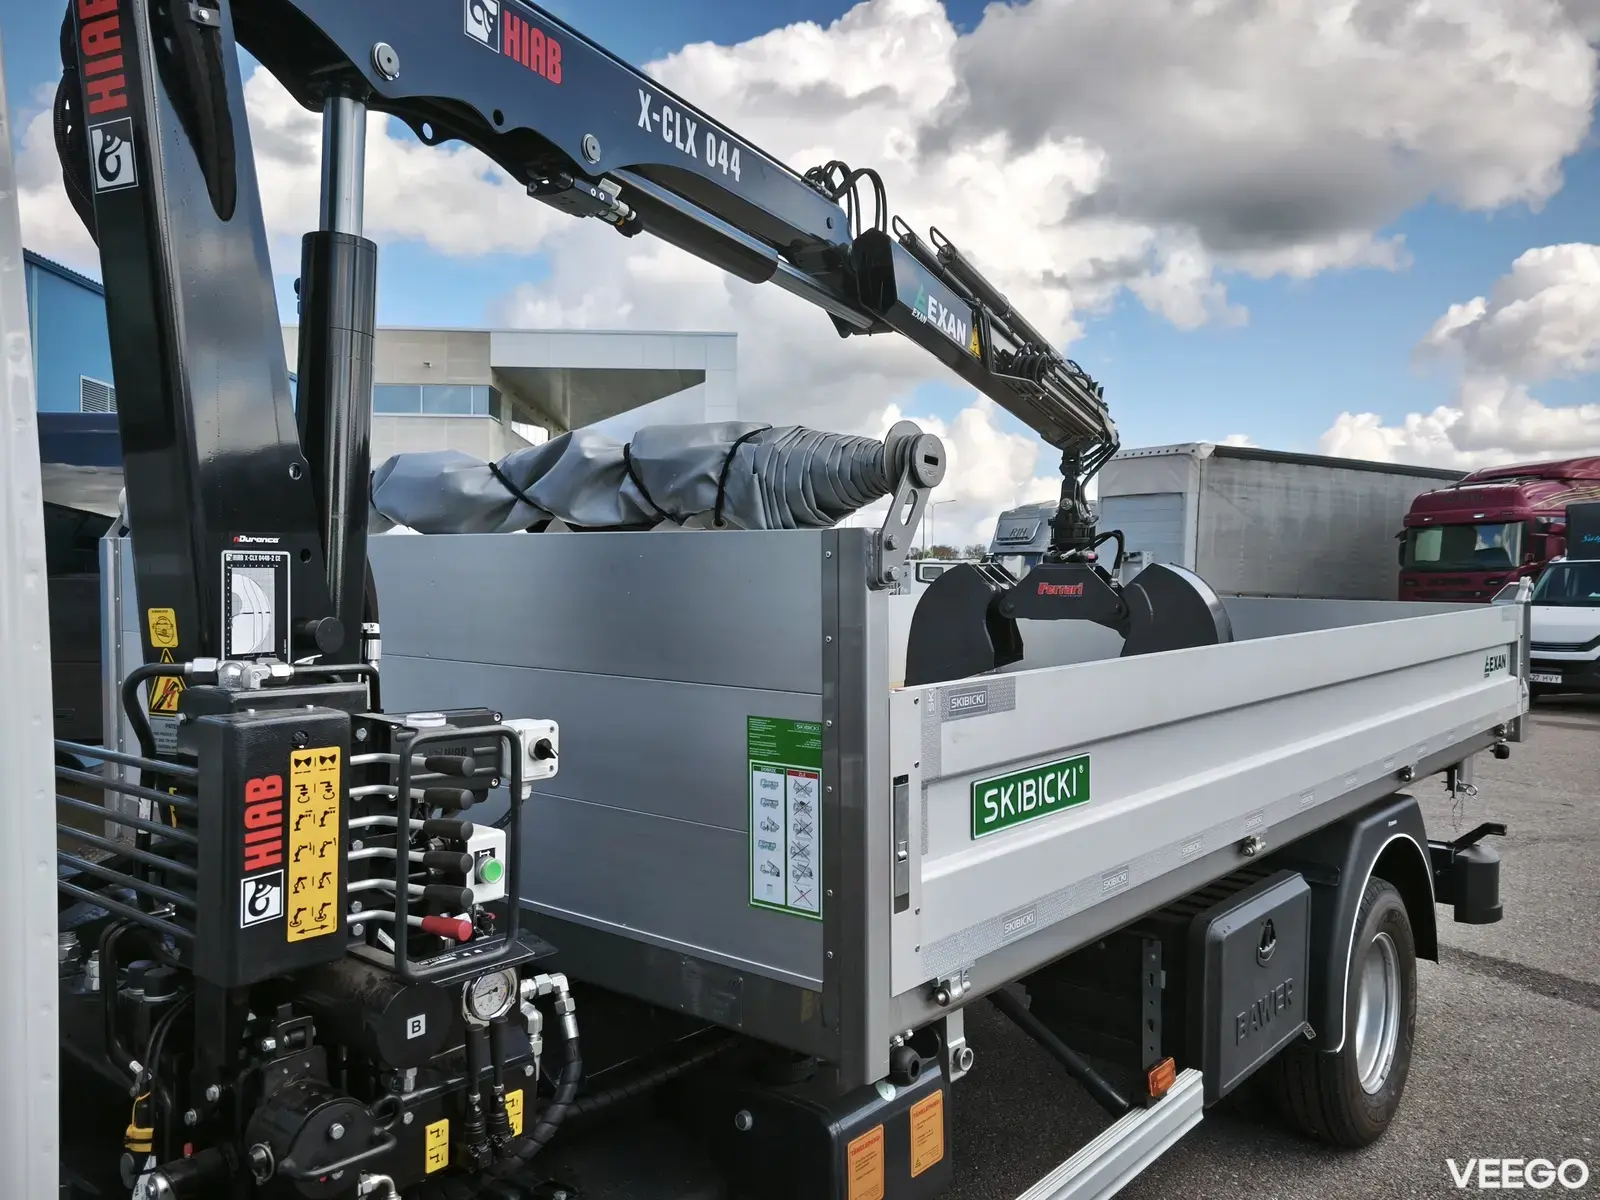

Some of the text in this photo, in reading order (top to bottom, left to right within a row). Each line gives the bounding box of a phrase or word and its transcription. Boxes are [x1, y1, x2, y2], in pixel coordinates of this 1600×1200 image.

[504, 9, 562, 85] HIAB
[637, 88, 741, 182] X-CLX 044
[927, 294, 966, 346] EXAN
[1038, 582, 1083, 595] Ferrari
[1490, 654, 1506, 672] EXAN
[951, 693, 985, 709] SKIBICKI
[244, 774, 283, 872] HIAB
[1103, 872, 1127, 890] SKIBICKI
[1004, 913, 1034, 934] SKIBICKI
[1236, 977, 1293, 1046] BAWER
[411, 1020, 421, 1034] B
